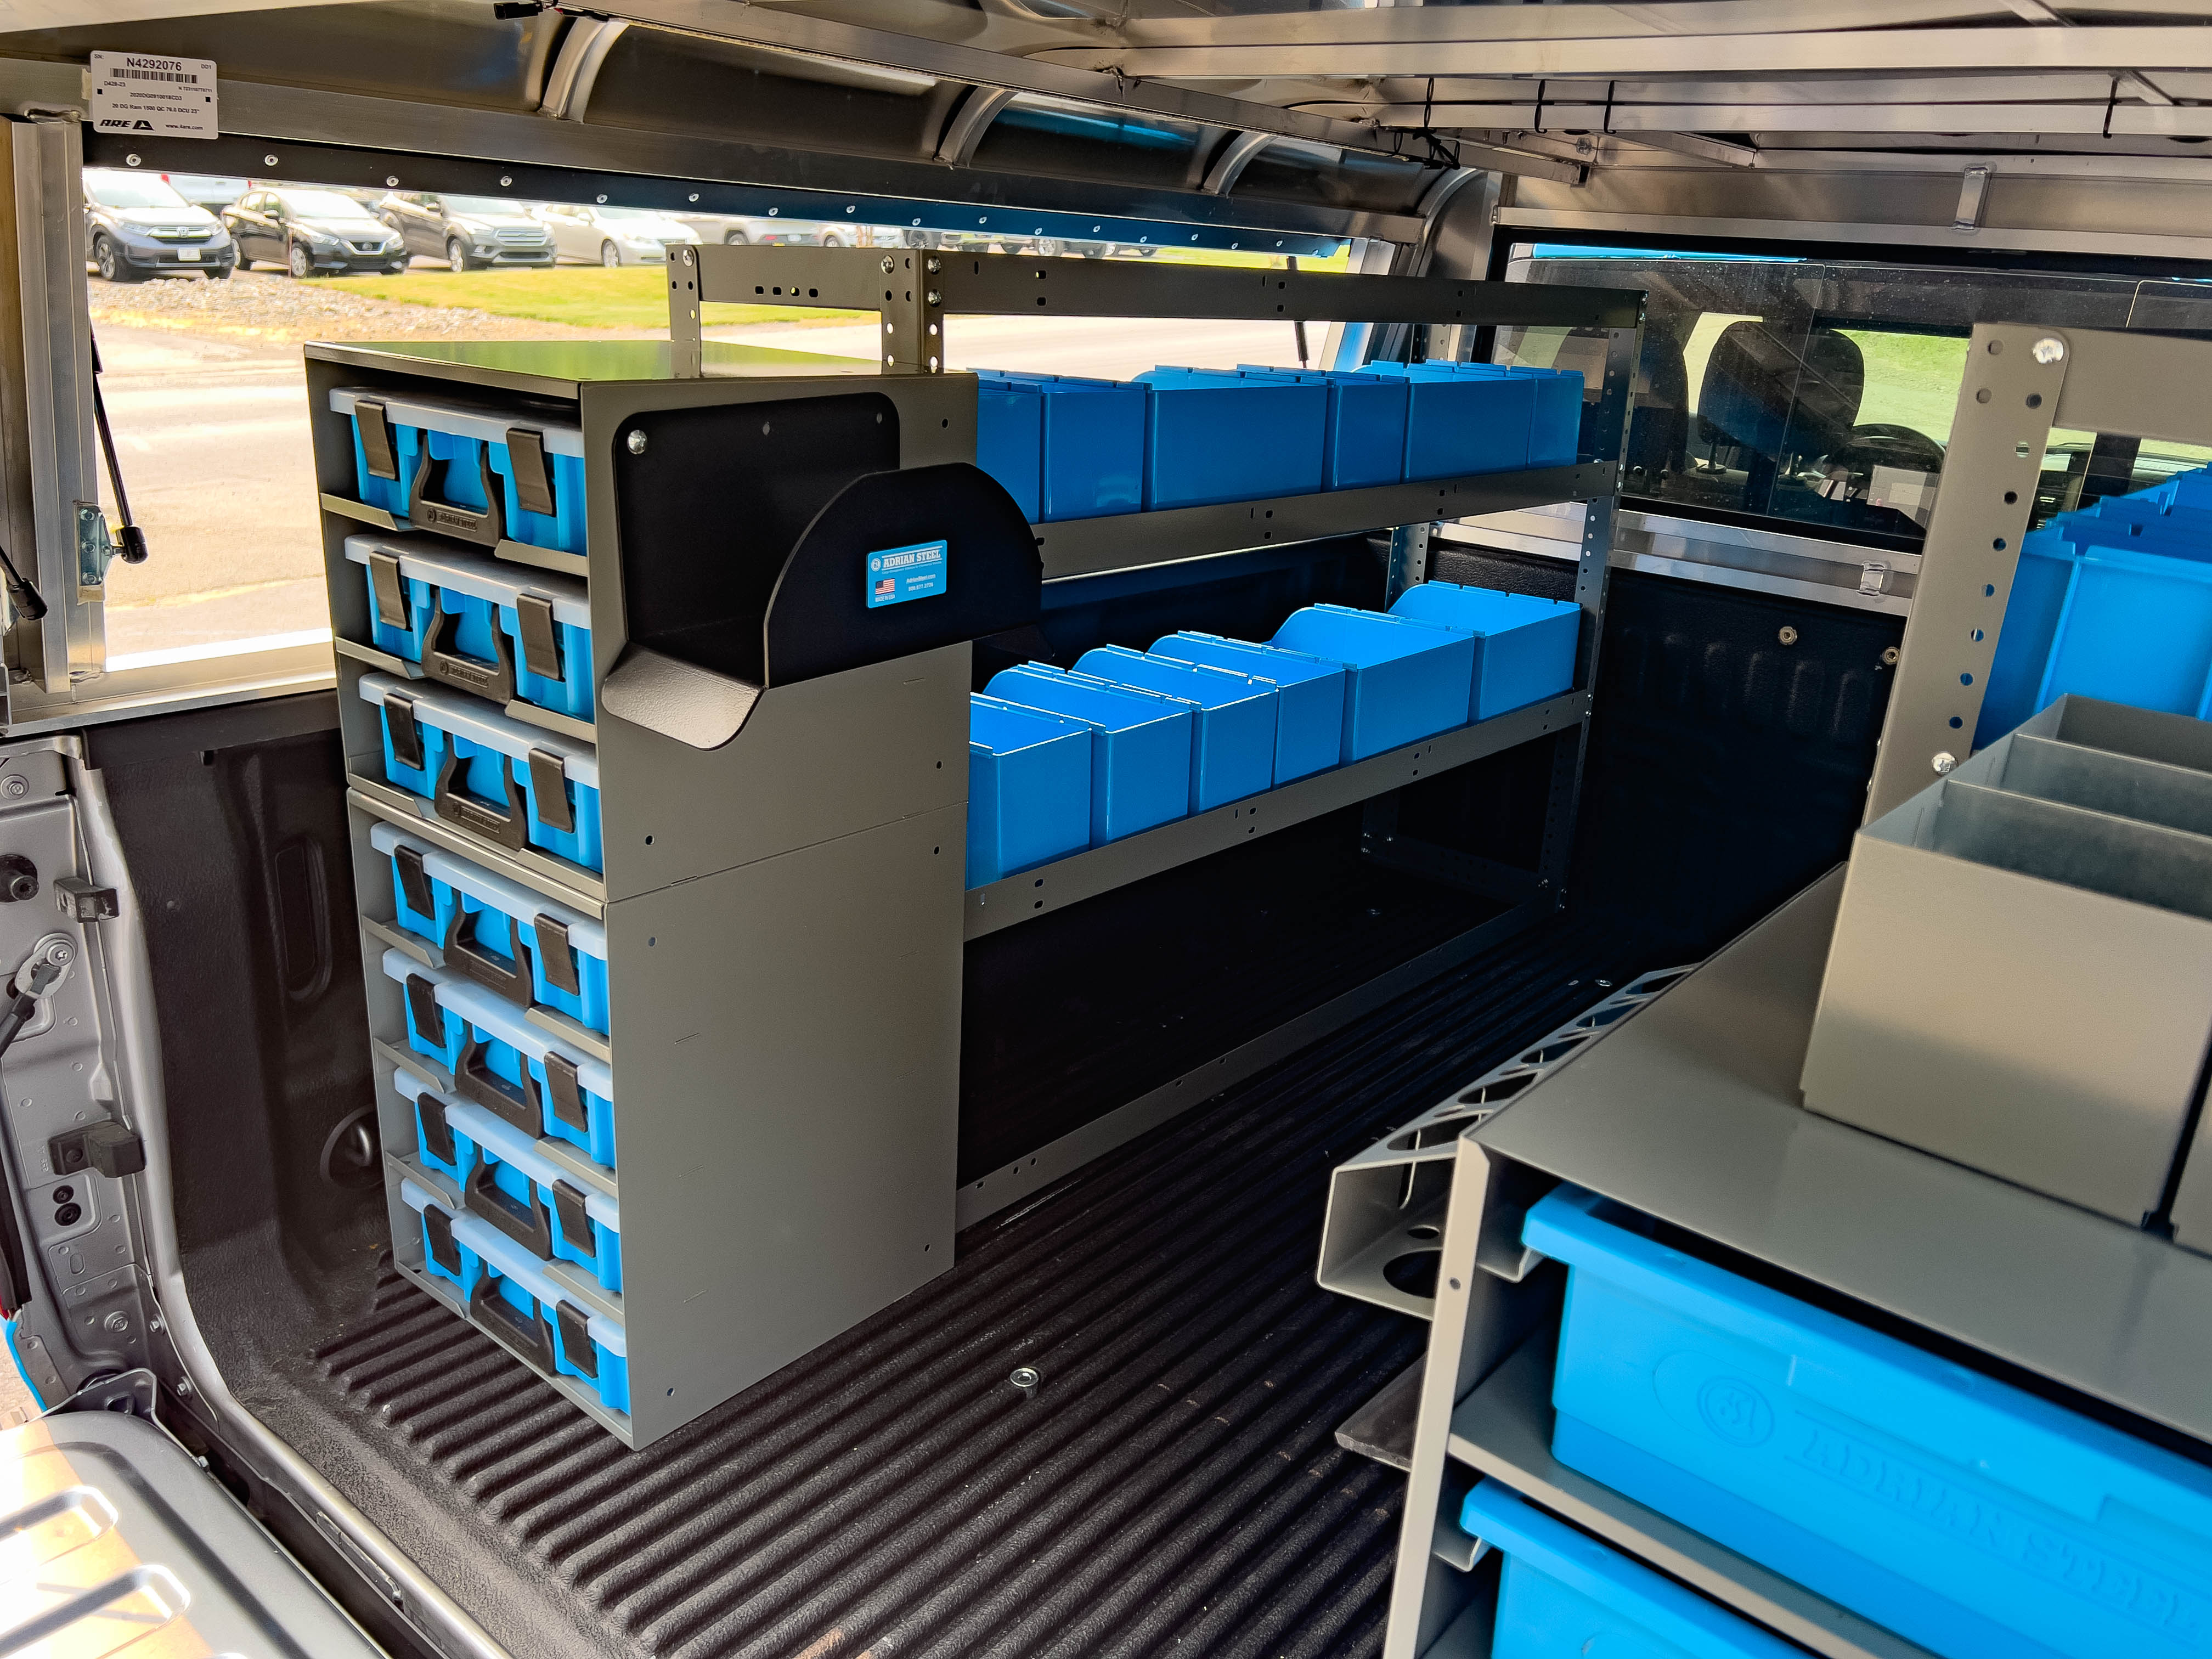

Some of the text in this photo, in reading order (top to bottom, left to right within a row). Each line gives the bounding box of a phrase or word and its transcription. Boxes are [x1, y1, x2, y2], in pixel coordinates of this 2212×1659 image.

[127, 57, 182, 71] N4292076
[100, 119, 132, 128] ARE
[883, 554, 915, 568] ADRIAN
[916, 549, 941, 562] STEEL
